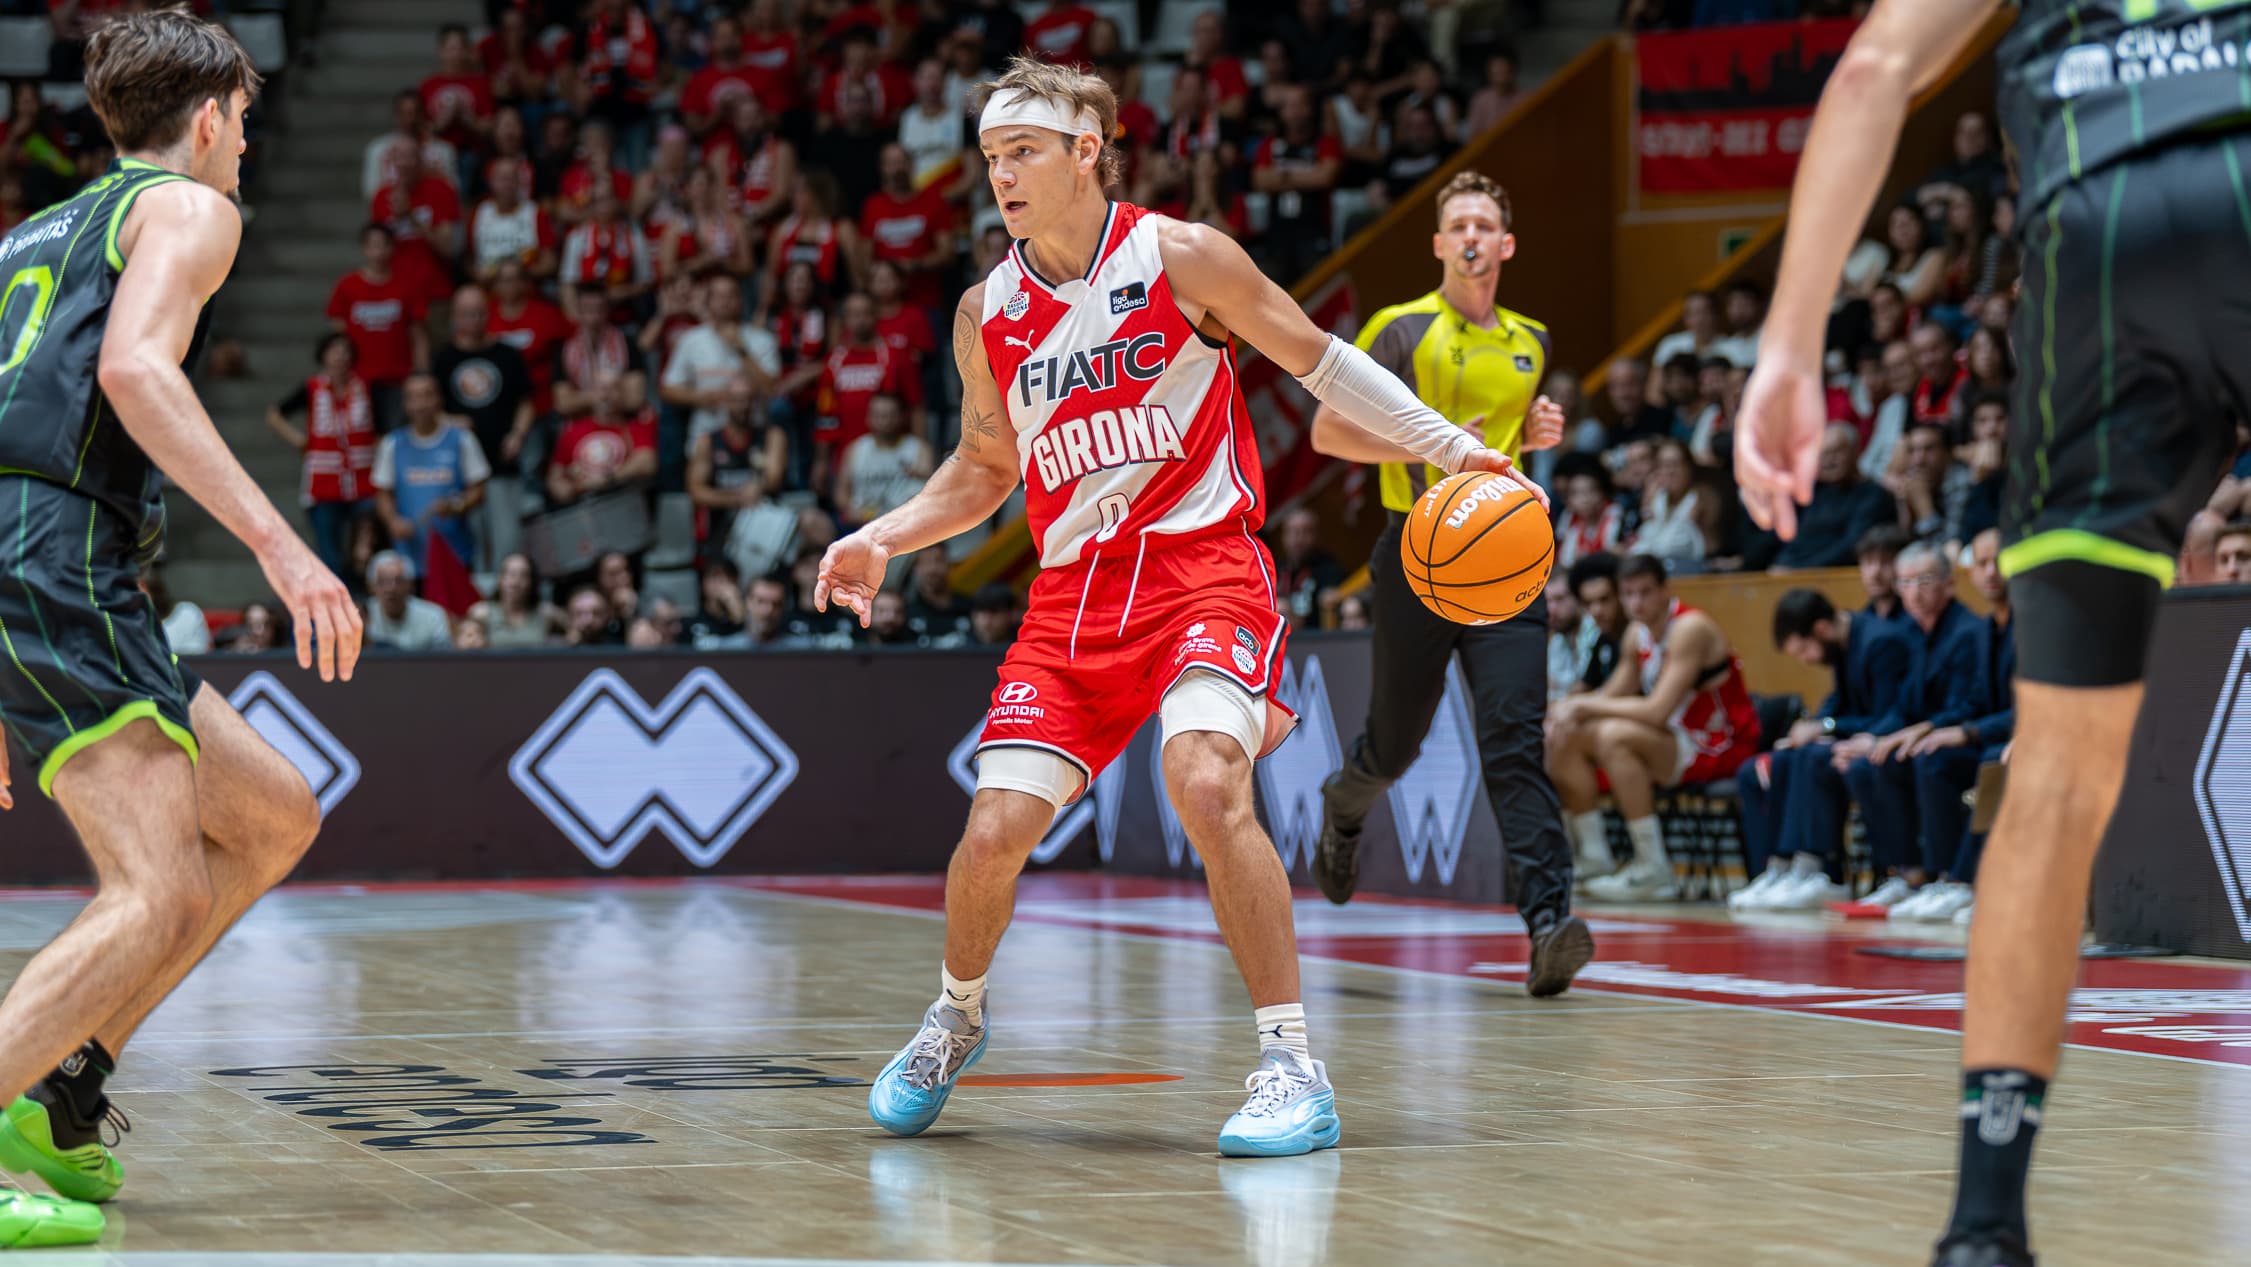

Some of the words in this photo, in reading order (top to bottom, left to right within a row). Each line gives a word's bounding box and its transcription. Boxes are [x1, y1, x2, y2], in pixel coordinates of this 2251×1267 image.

[1112, 296, 1127, 307] liga
[1113, 297, 1146, 312] endesa
[1018, 332, 1165, 408] FIATC
[1031, 404, 1187, 495] GIRONA
[1096, 492, 1130, 543] 0
[1238, 632, 1255, 650] acb
